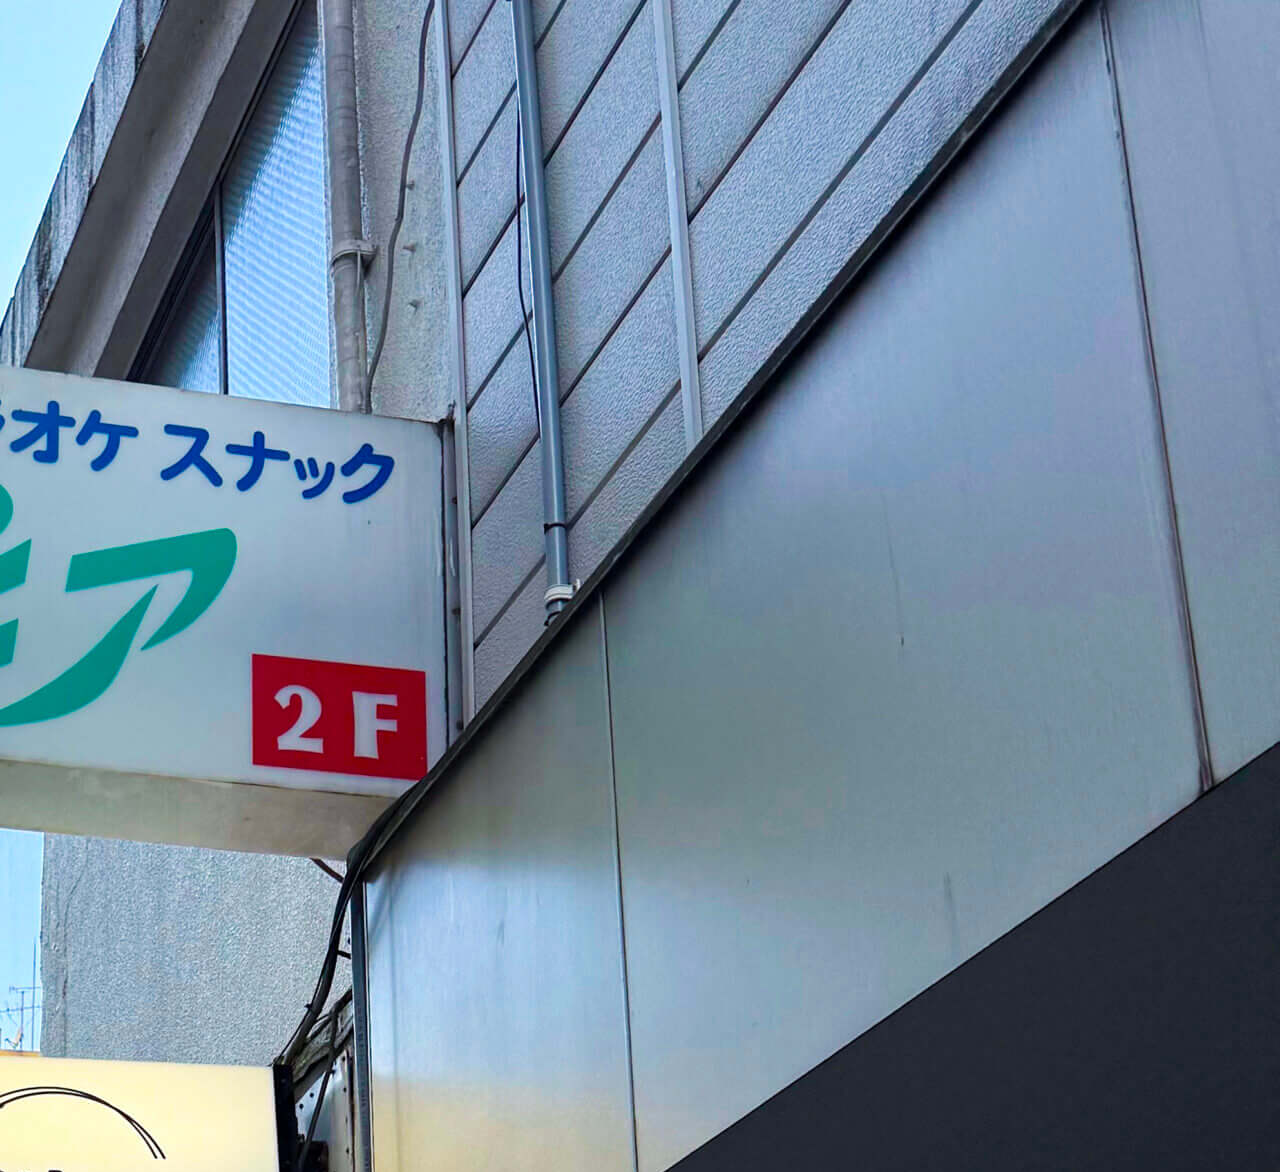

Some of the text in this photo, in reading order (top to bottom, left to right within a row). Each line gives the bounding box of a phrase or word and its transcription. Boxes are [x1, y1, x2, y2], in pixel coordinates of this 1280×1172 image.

[160, 424, 395, 504] スナック
[274, 684, 398, 759] 2F
